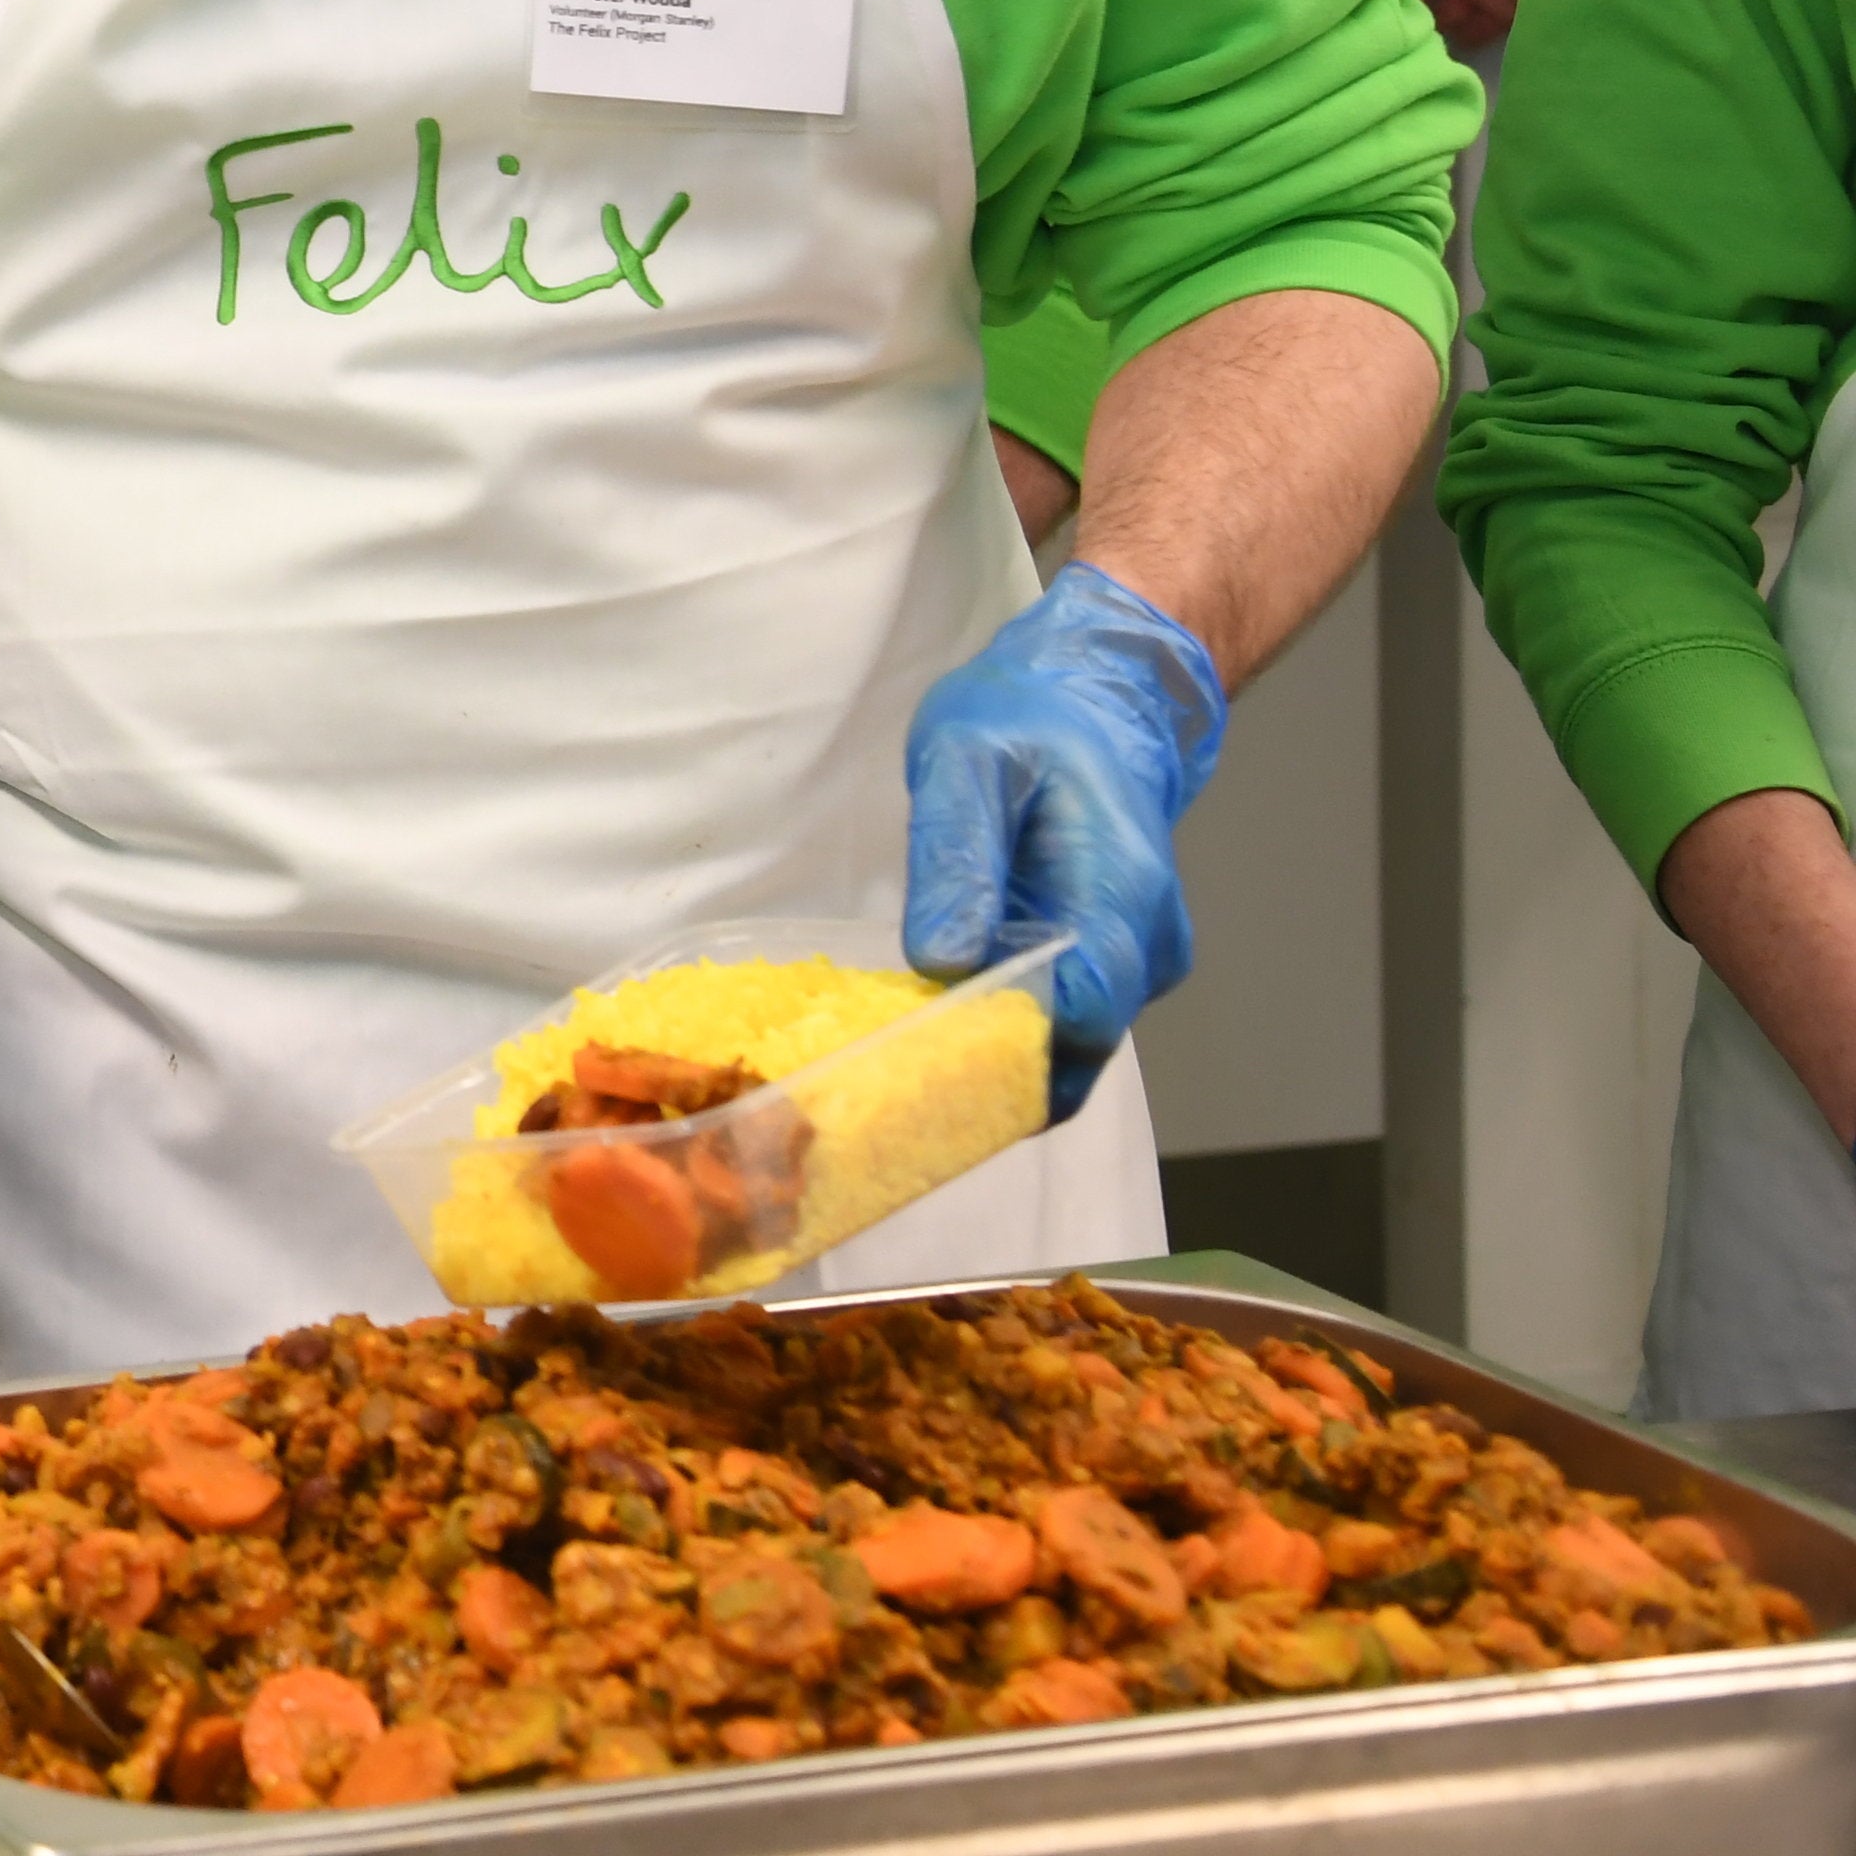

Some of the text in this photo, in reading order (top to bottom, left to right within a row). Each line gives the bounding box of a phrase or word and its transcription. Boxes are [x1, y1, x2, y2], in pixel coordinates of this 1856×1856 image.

[549, 5, 607, 20] Volunteer
[548, 20, 667, 44] The Felix Project
[205, 117, 690, 326] Felix
